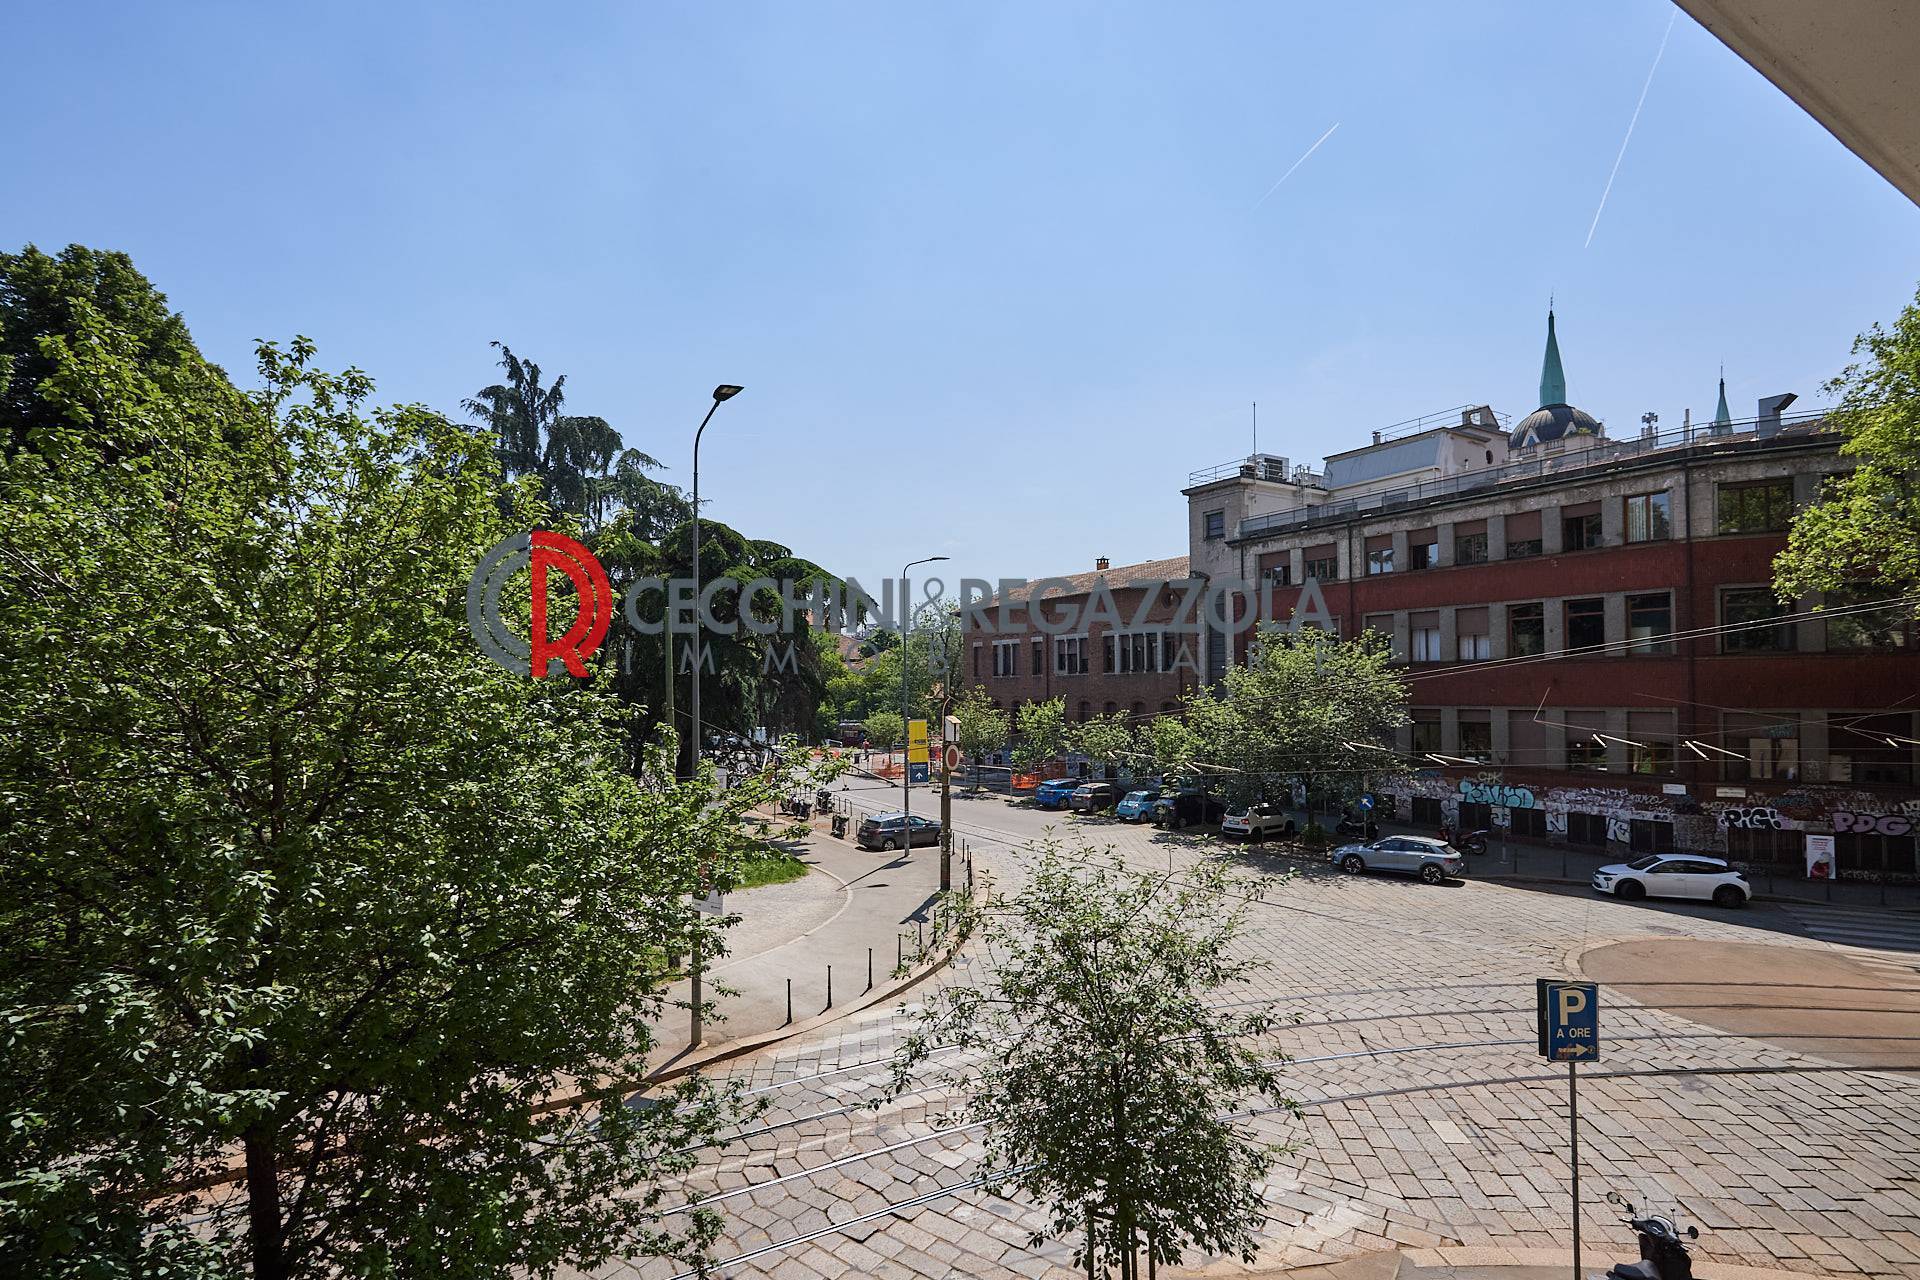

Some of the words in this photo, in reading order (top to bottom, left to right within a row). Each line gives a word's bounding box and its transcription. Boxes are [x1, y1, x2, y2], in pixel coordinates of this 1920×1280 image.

[1559, 989, 1586, 1025] P
[1556, 1028, 1564, 1038] A
[1569, 1027, 1591, 1038] ORE
